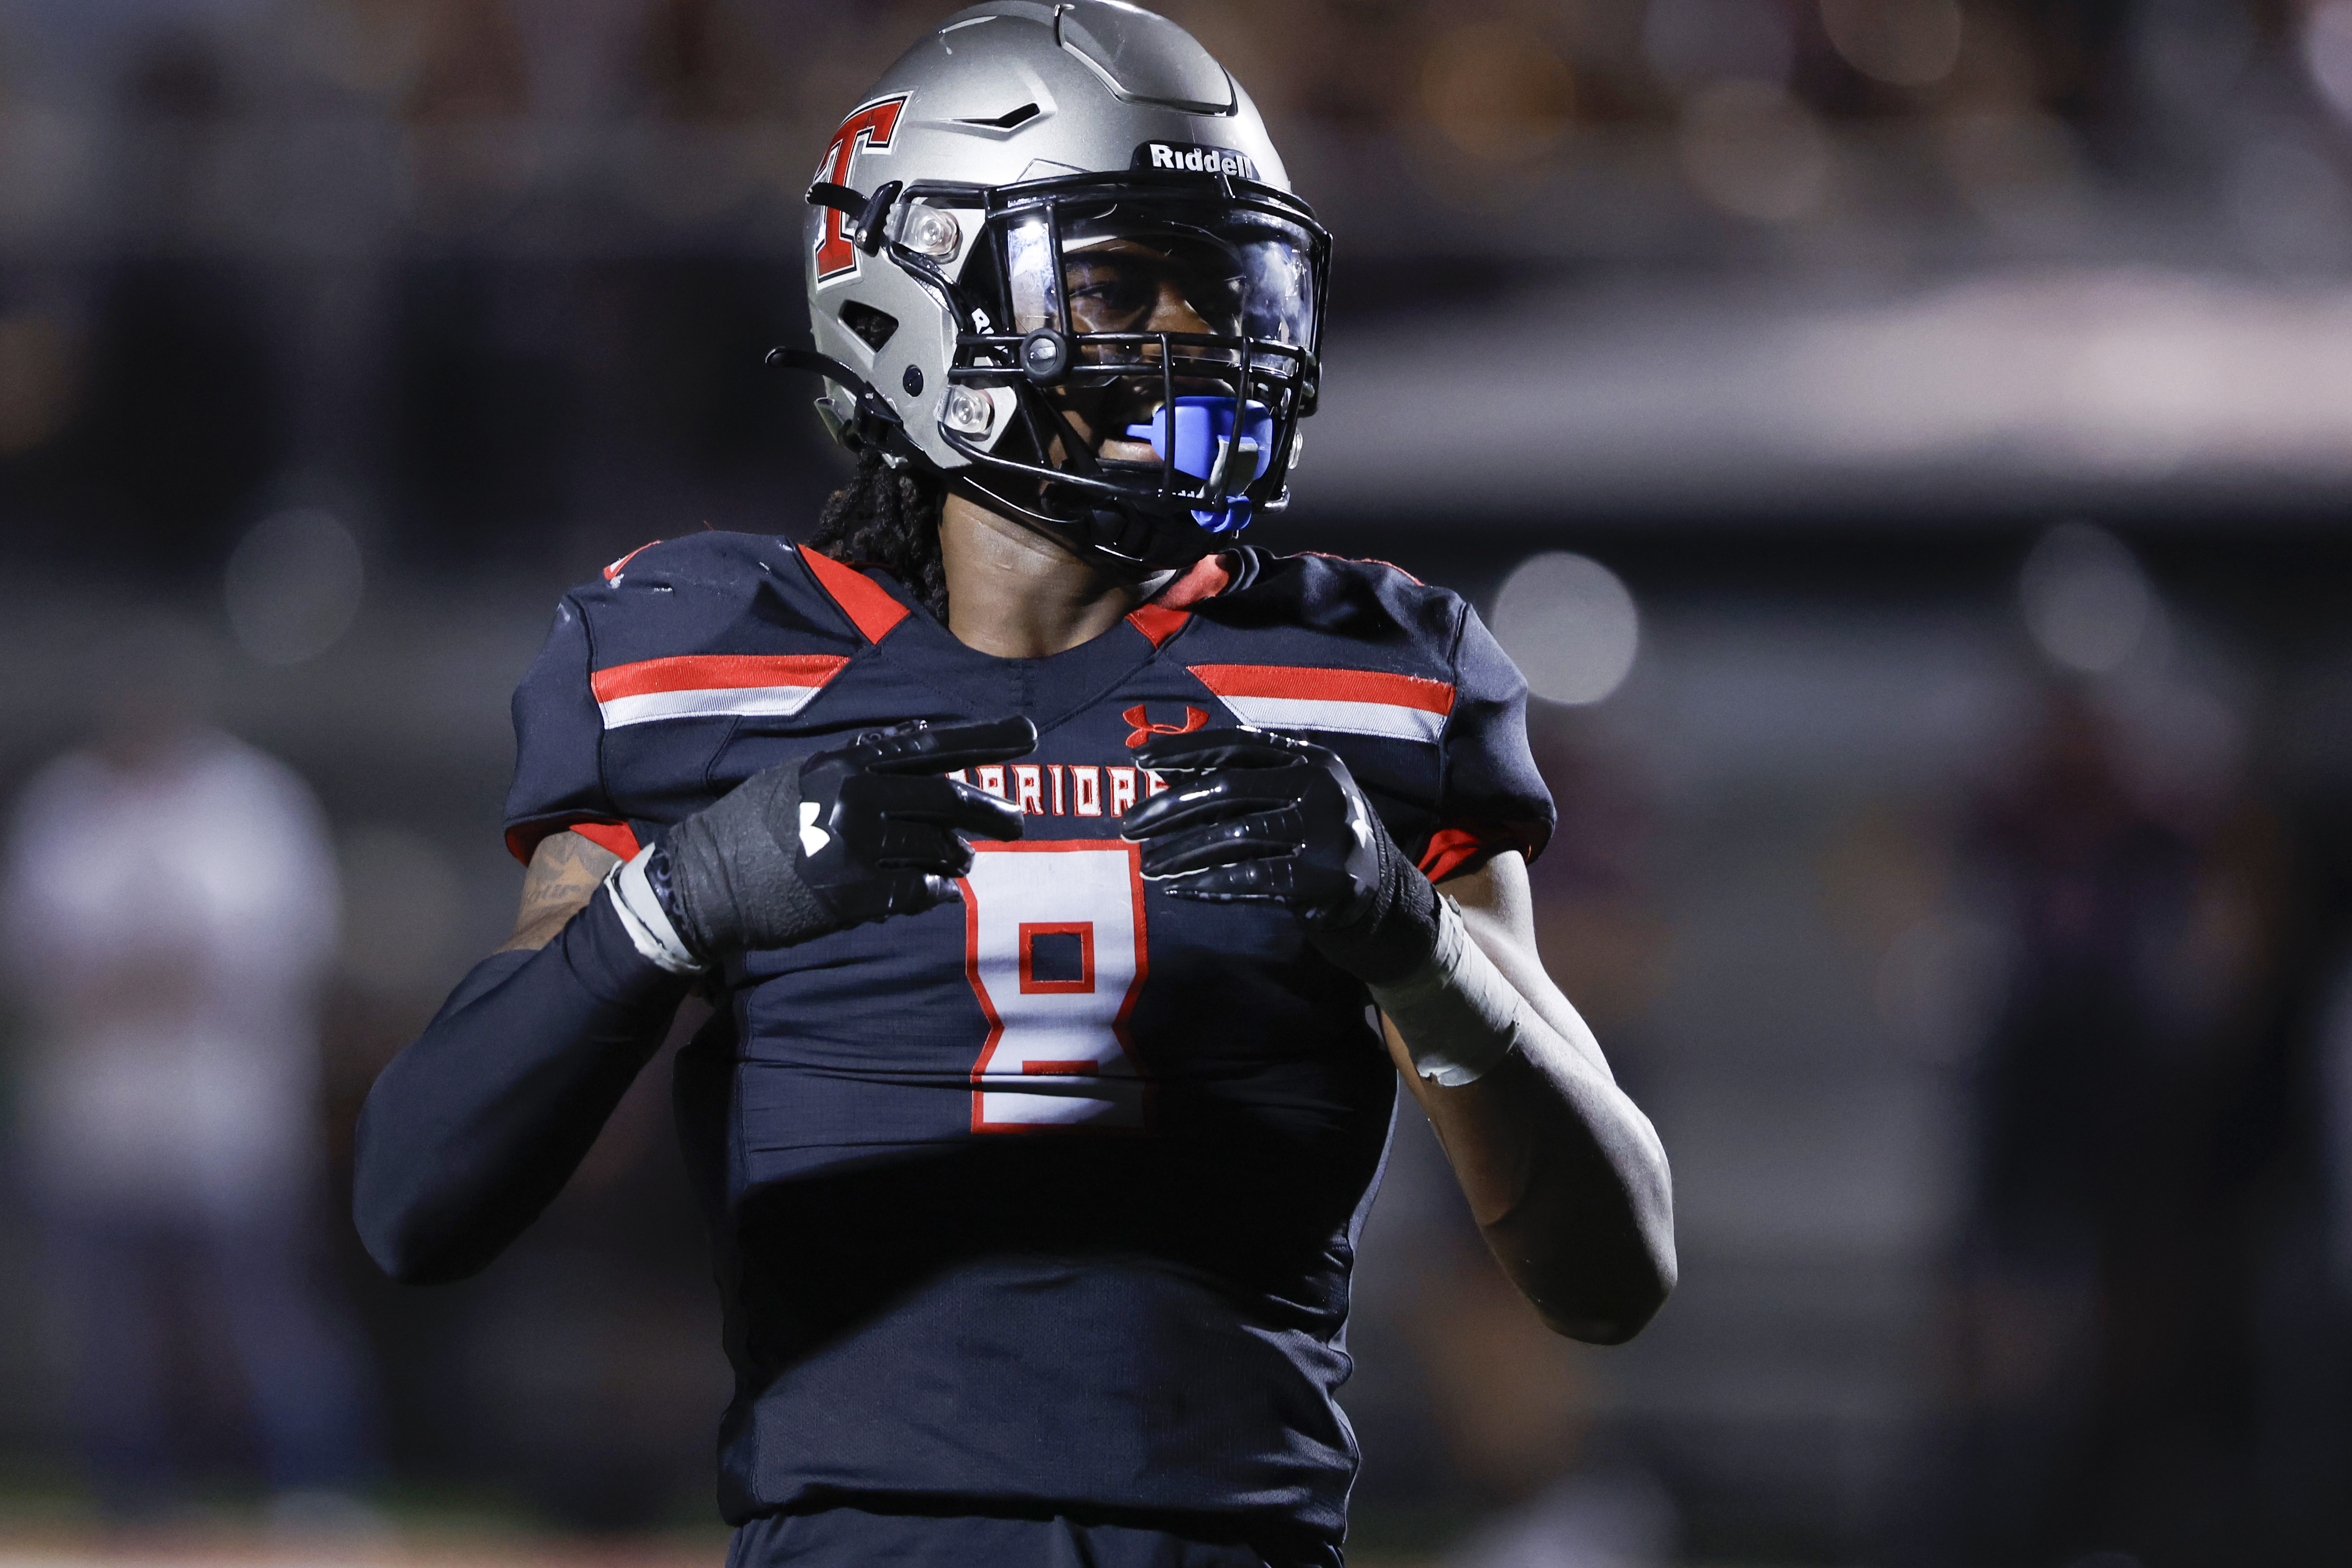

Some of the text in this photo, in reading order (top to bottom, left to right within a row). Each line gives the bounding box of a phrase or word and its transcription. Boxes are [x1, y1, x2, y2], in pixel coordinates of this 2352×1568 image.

[814, 90, 914, 292] T
[1149, 144, 1252, 179] Riddell
[945, 764, 1171, 817] RRIOR
[956, 839, 1155, 1136] 8
